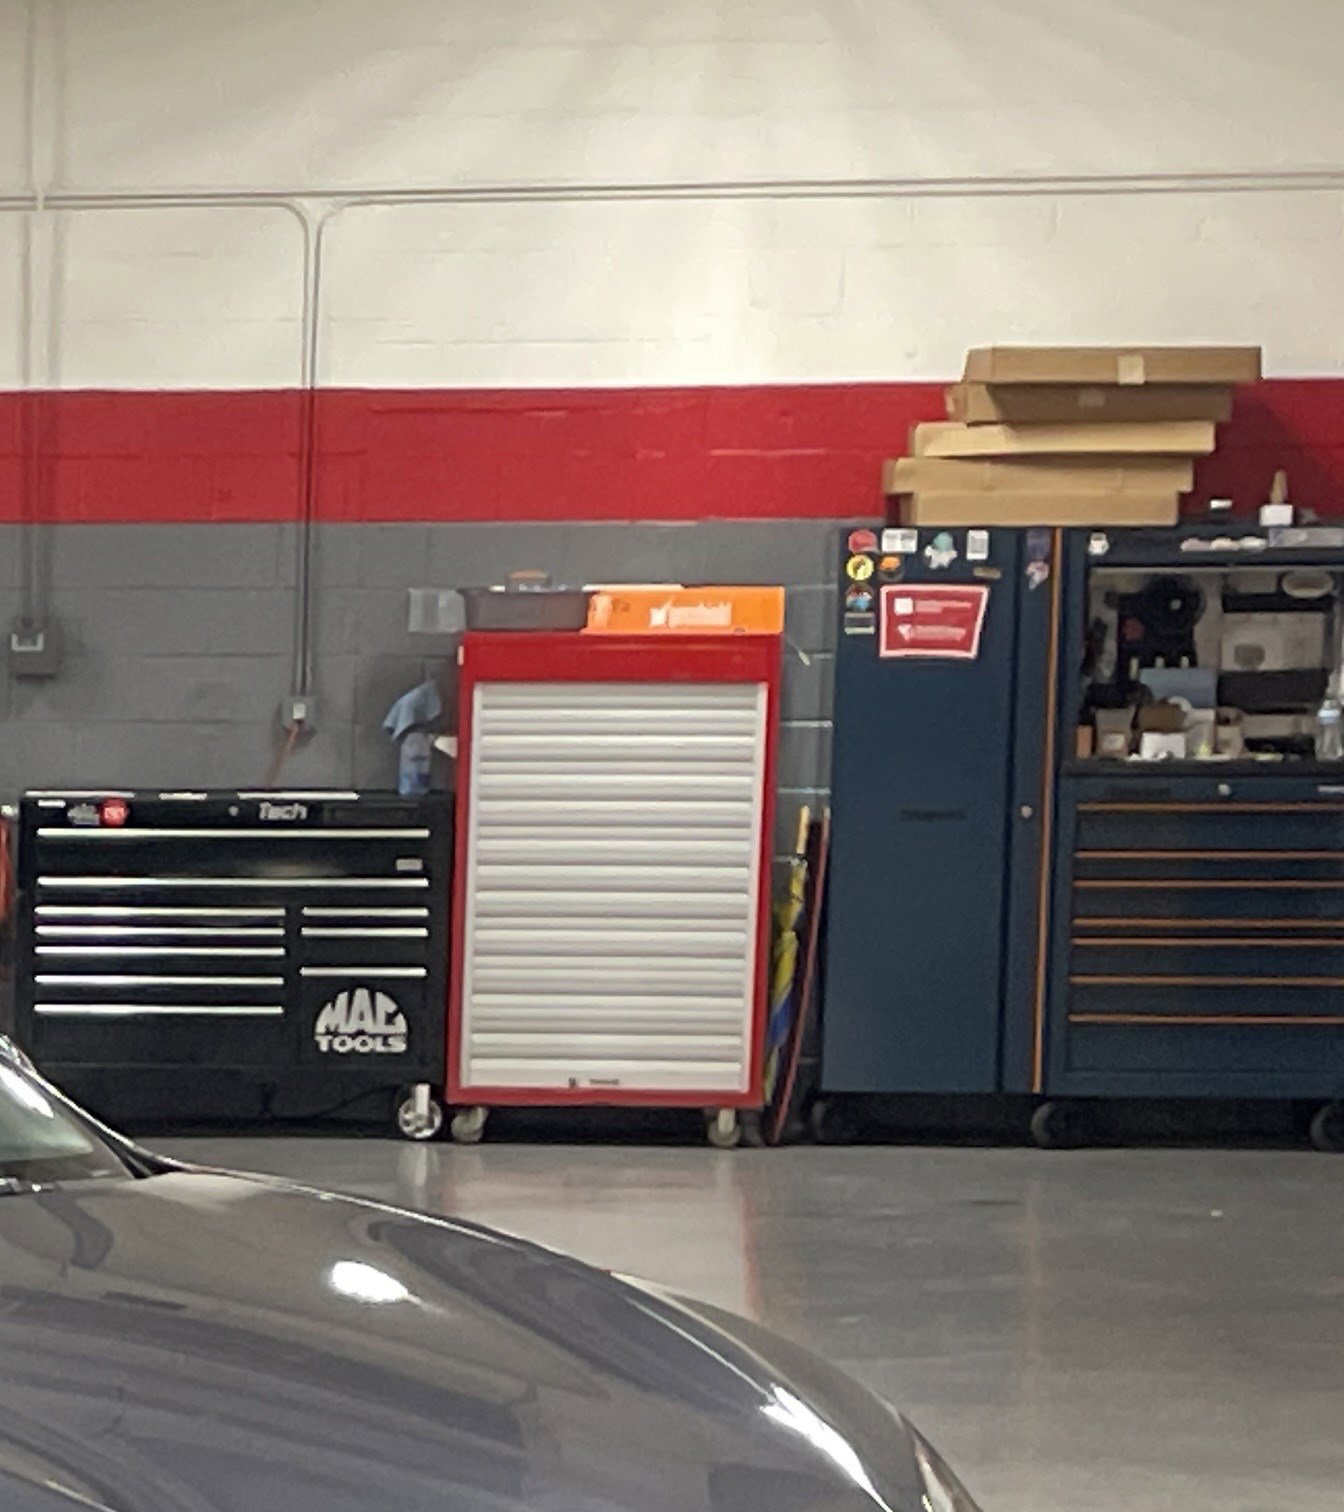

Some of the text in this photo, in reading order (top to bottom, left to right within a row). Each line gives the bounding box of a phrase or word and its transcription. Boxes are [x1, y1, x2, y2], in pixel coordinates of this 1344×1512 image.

[260, 801, 306, 819] Tech
[315, 987, 408, 1034] MAC
[314, 1034, 408, 1053] TOOLS
